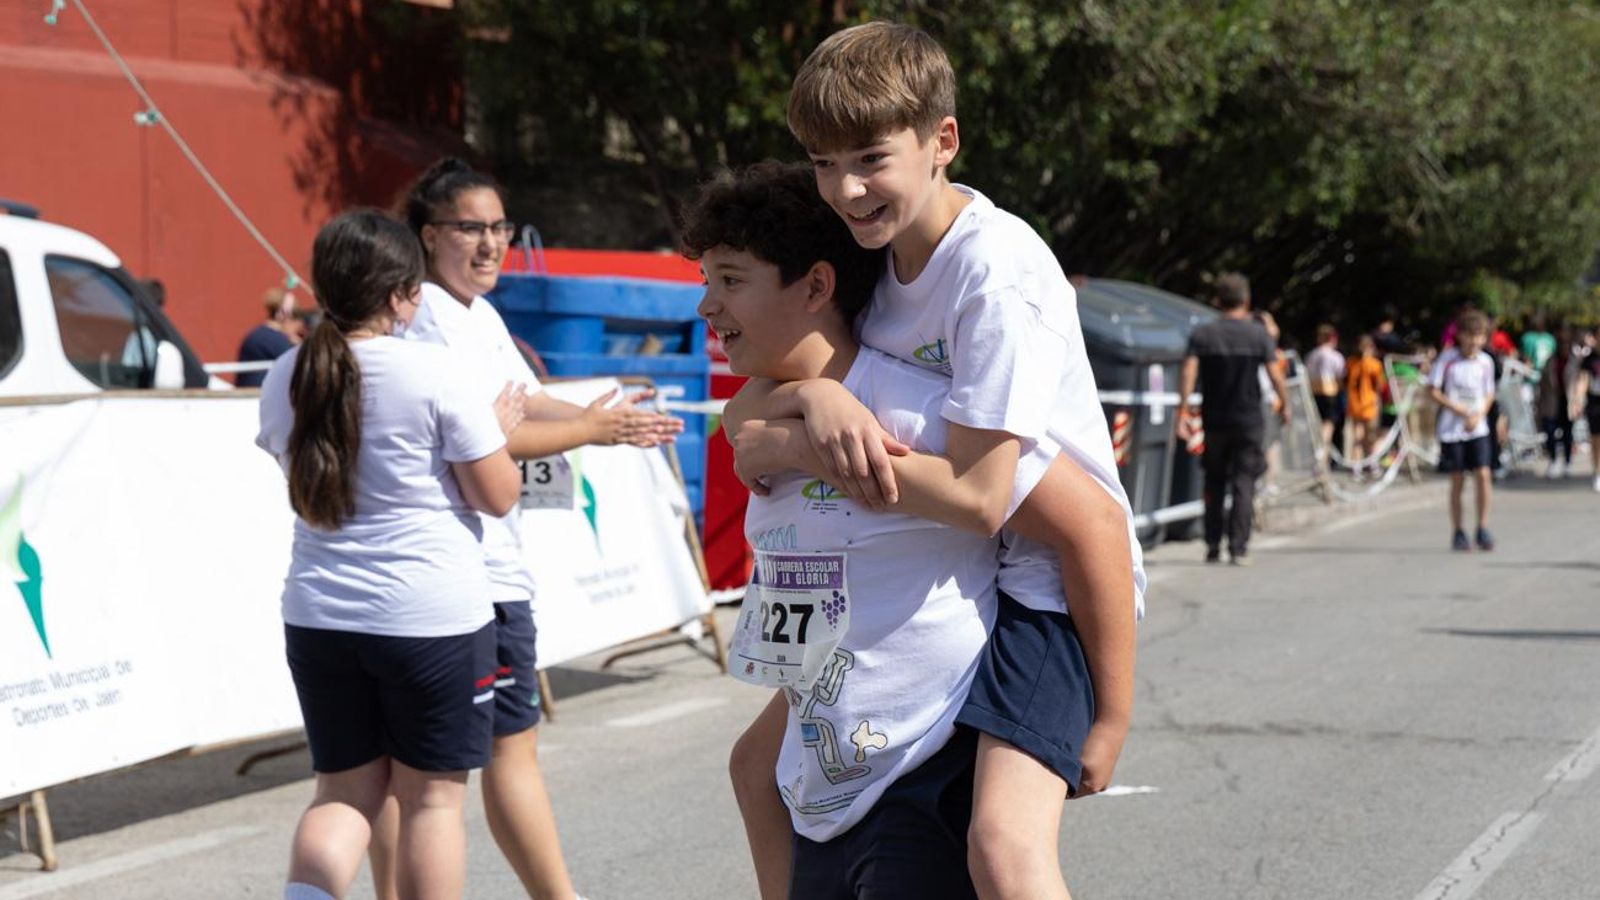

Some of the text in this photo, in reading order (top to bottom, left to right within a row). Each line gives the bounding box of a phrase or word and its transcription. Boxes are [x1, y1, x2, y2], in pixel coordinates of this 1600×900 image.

[805, 561, 839, 573] ESCOLAR
[782, 572, 829, 585] LA GLORIA
[761, 601, 814, 644] 227
